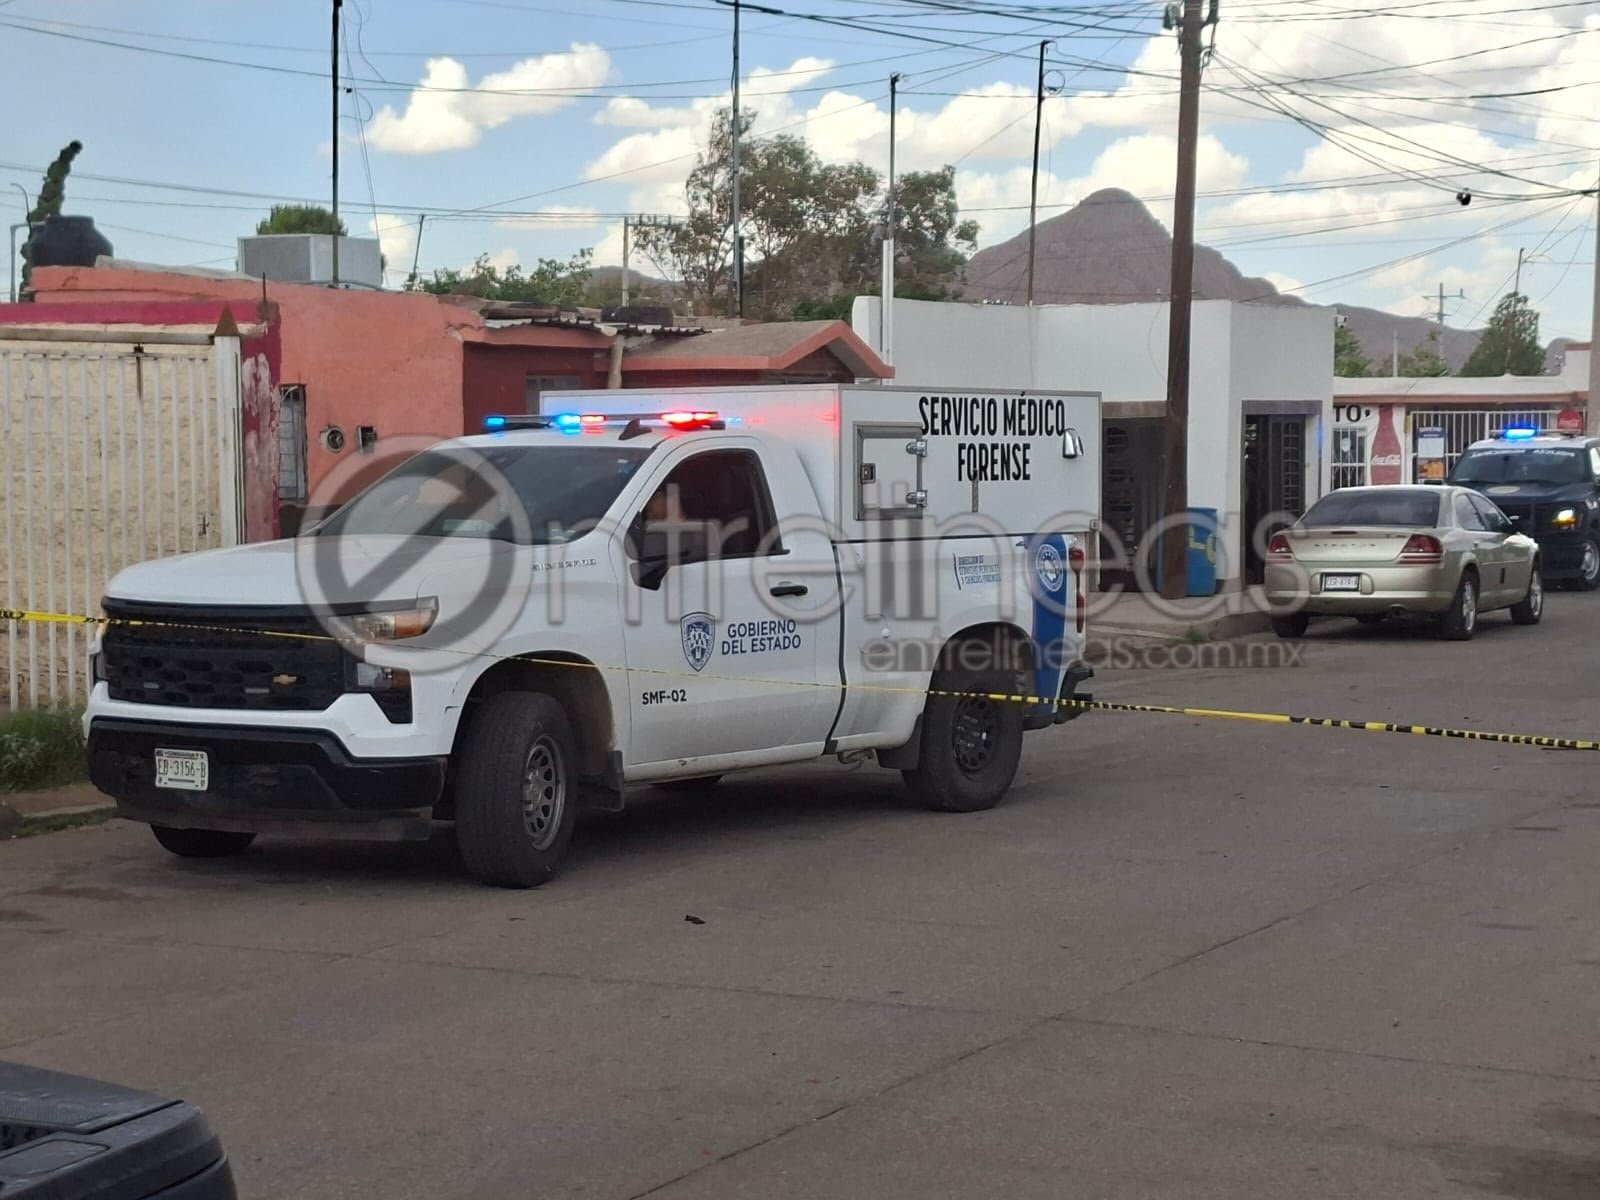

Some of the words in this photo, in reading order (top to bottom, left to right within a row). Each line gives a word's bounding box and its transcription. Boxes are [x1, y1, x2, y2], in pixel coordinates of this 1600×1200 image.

[919, 396, 998, 436] SERVICIO
[1003, 391, 1065, 436] MÉDICO
[957, 442, 1031, 482] FORENSE
[727, 619, 796, 638] GOBIERNO
[721, 640, 747, 655] DEL
[751, 635, 801, 653] ESTADO
[642, 689, 687, 705] SMF-02
